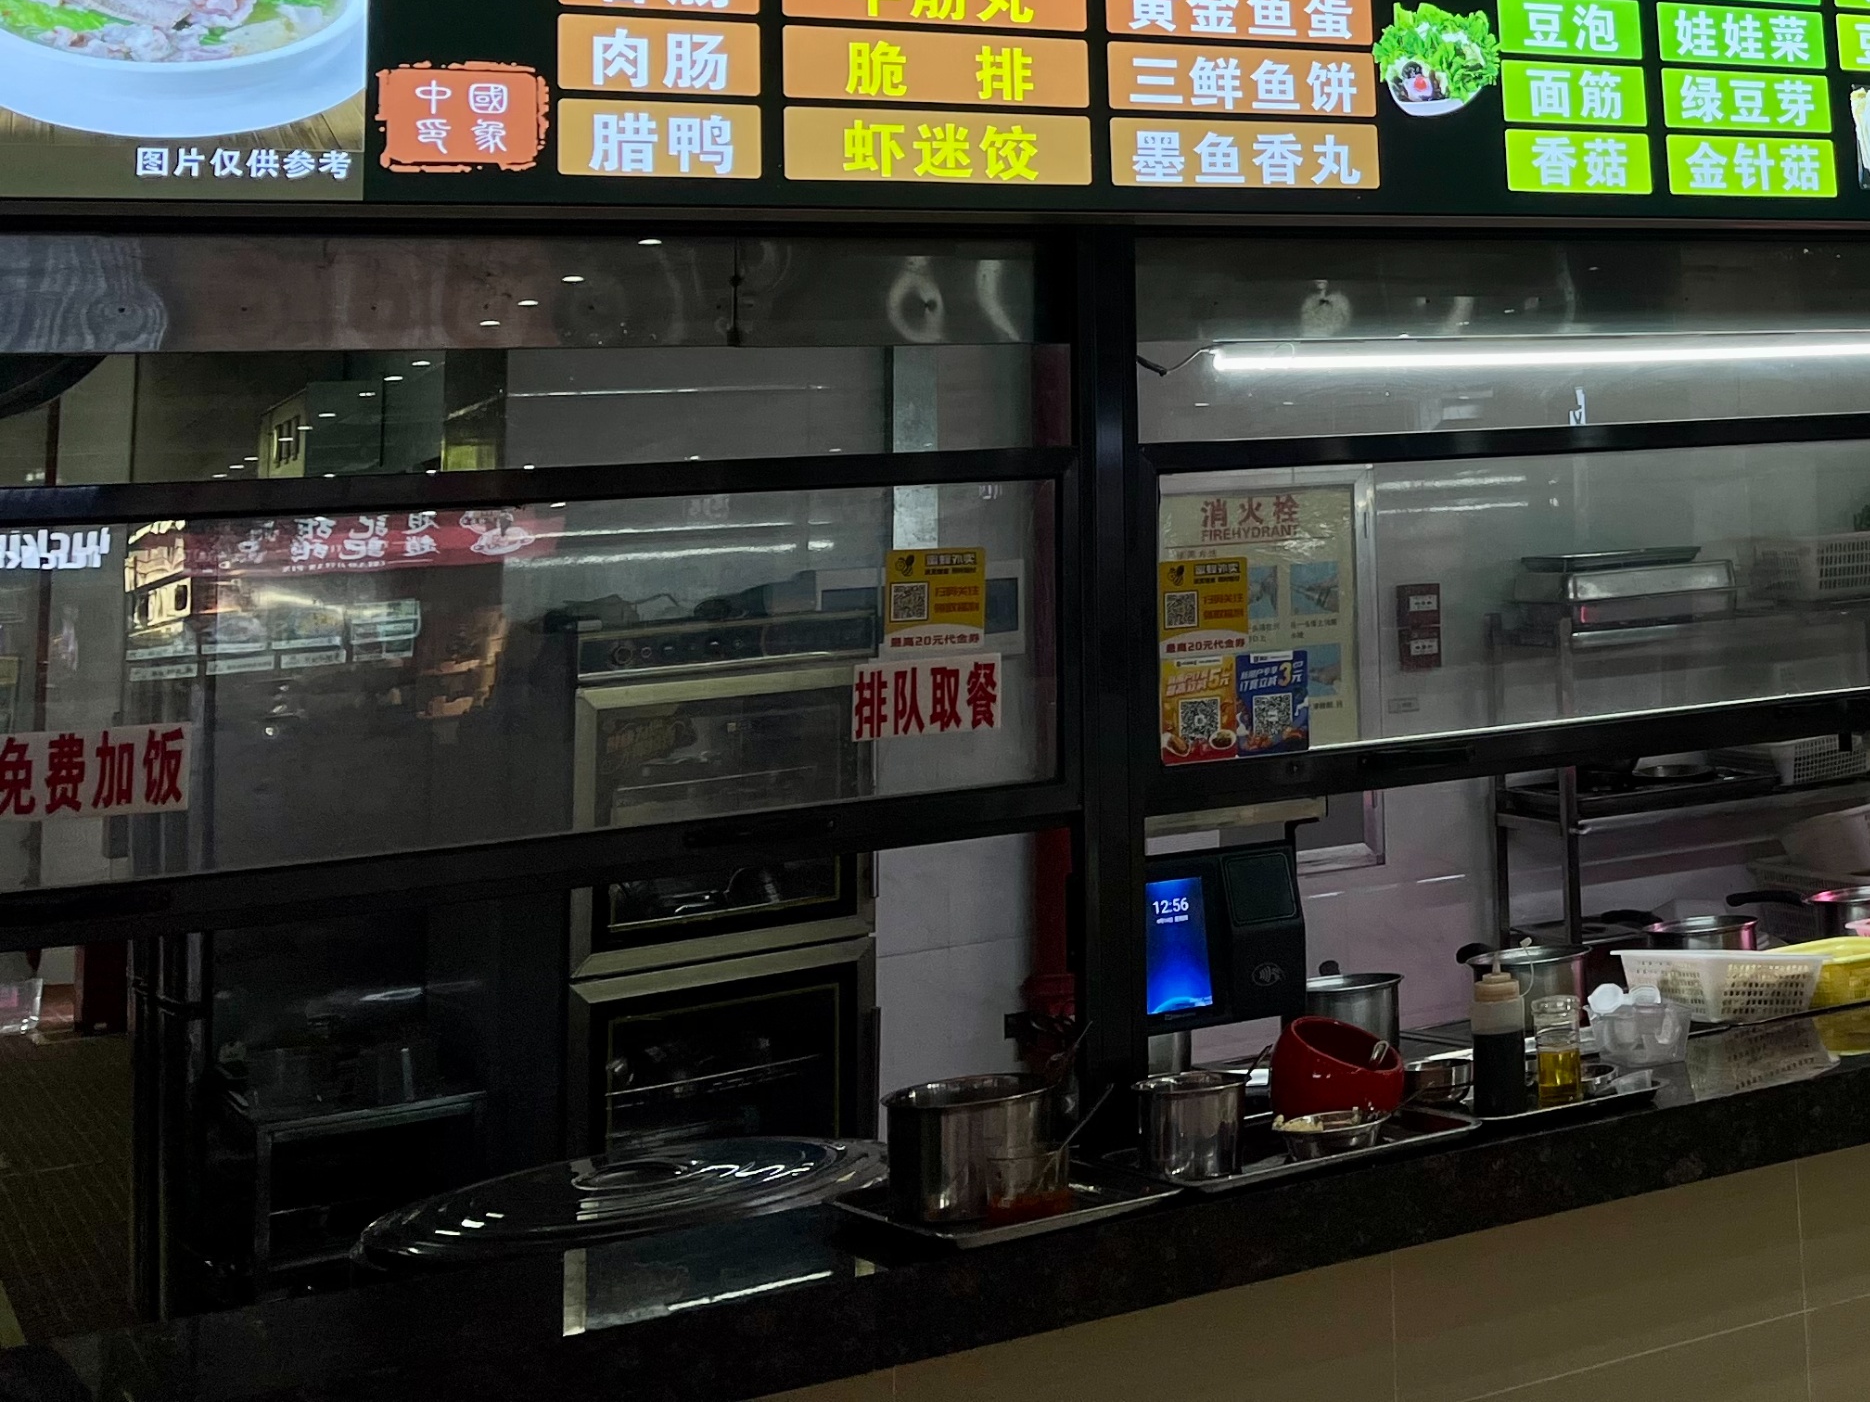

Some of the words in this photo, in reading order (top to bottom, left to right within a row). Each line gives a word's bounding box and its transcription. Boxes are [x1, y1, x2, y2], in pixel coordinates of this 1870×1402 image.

[1523, 2, 1619, 53] 豆泡
[1675, 10, 1811, 63] 娃娃菜
[591, 26, 729, 91] 肉肠
[845, 40, 1034, 102] 脆排
[1129, 55, 1358, 113] 三鲜鱼饼
[1526, 68, 1623, 121] 面筋
[1680, 74, 1816, 127] 绿豆芽
[135, 145, 352, 180] 图片仅供参考
[588, 111, 734, 176] 腊鸭
[842, 120, 1039, 182] 虾迷饺
[1131, 129, 1361, 186] 墨鱼香丸
[1531, 137, 1628, 188] 香菇
[1685, 141, 1821, 192] 金针菇
[1200, 494, 1301, 529] 消火栓
[852, 661, 999, 739] 排队取餐
[0, 725, 186, 816] 免费加饭
[1151, 897, 1190, 915] 12:56
